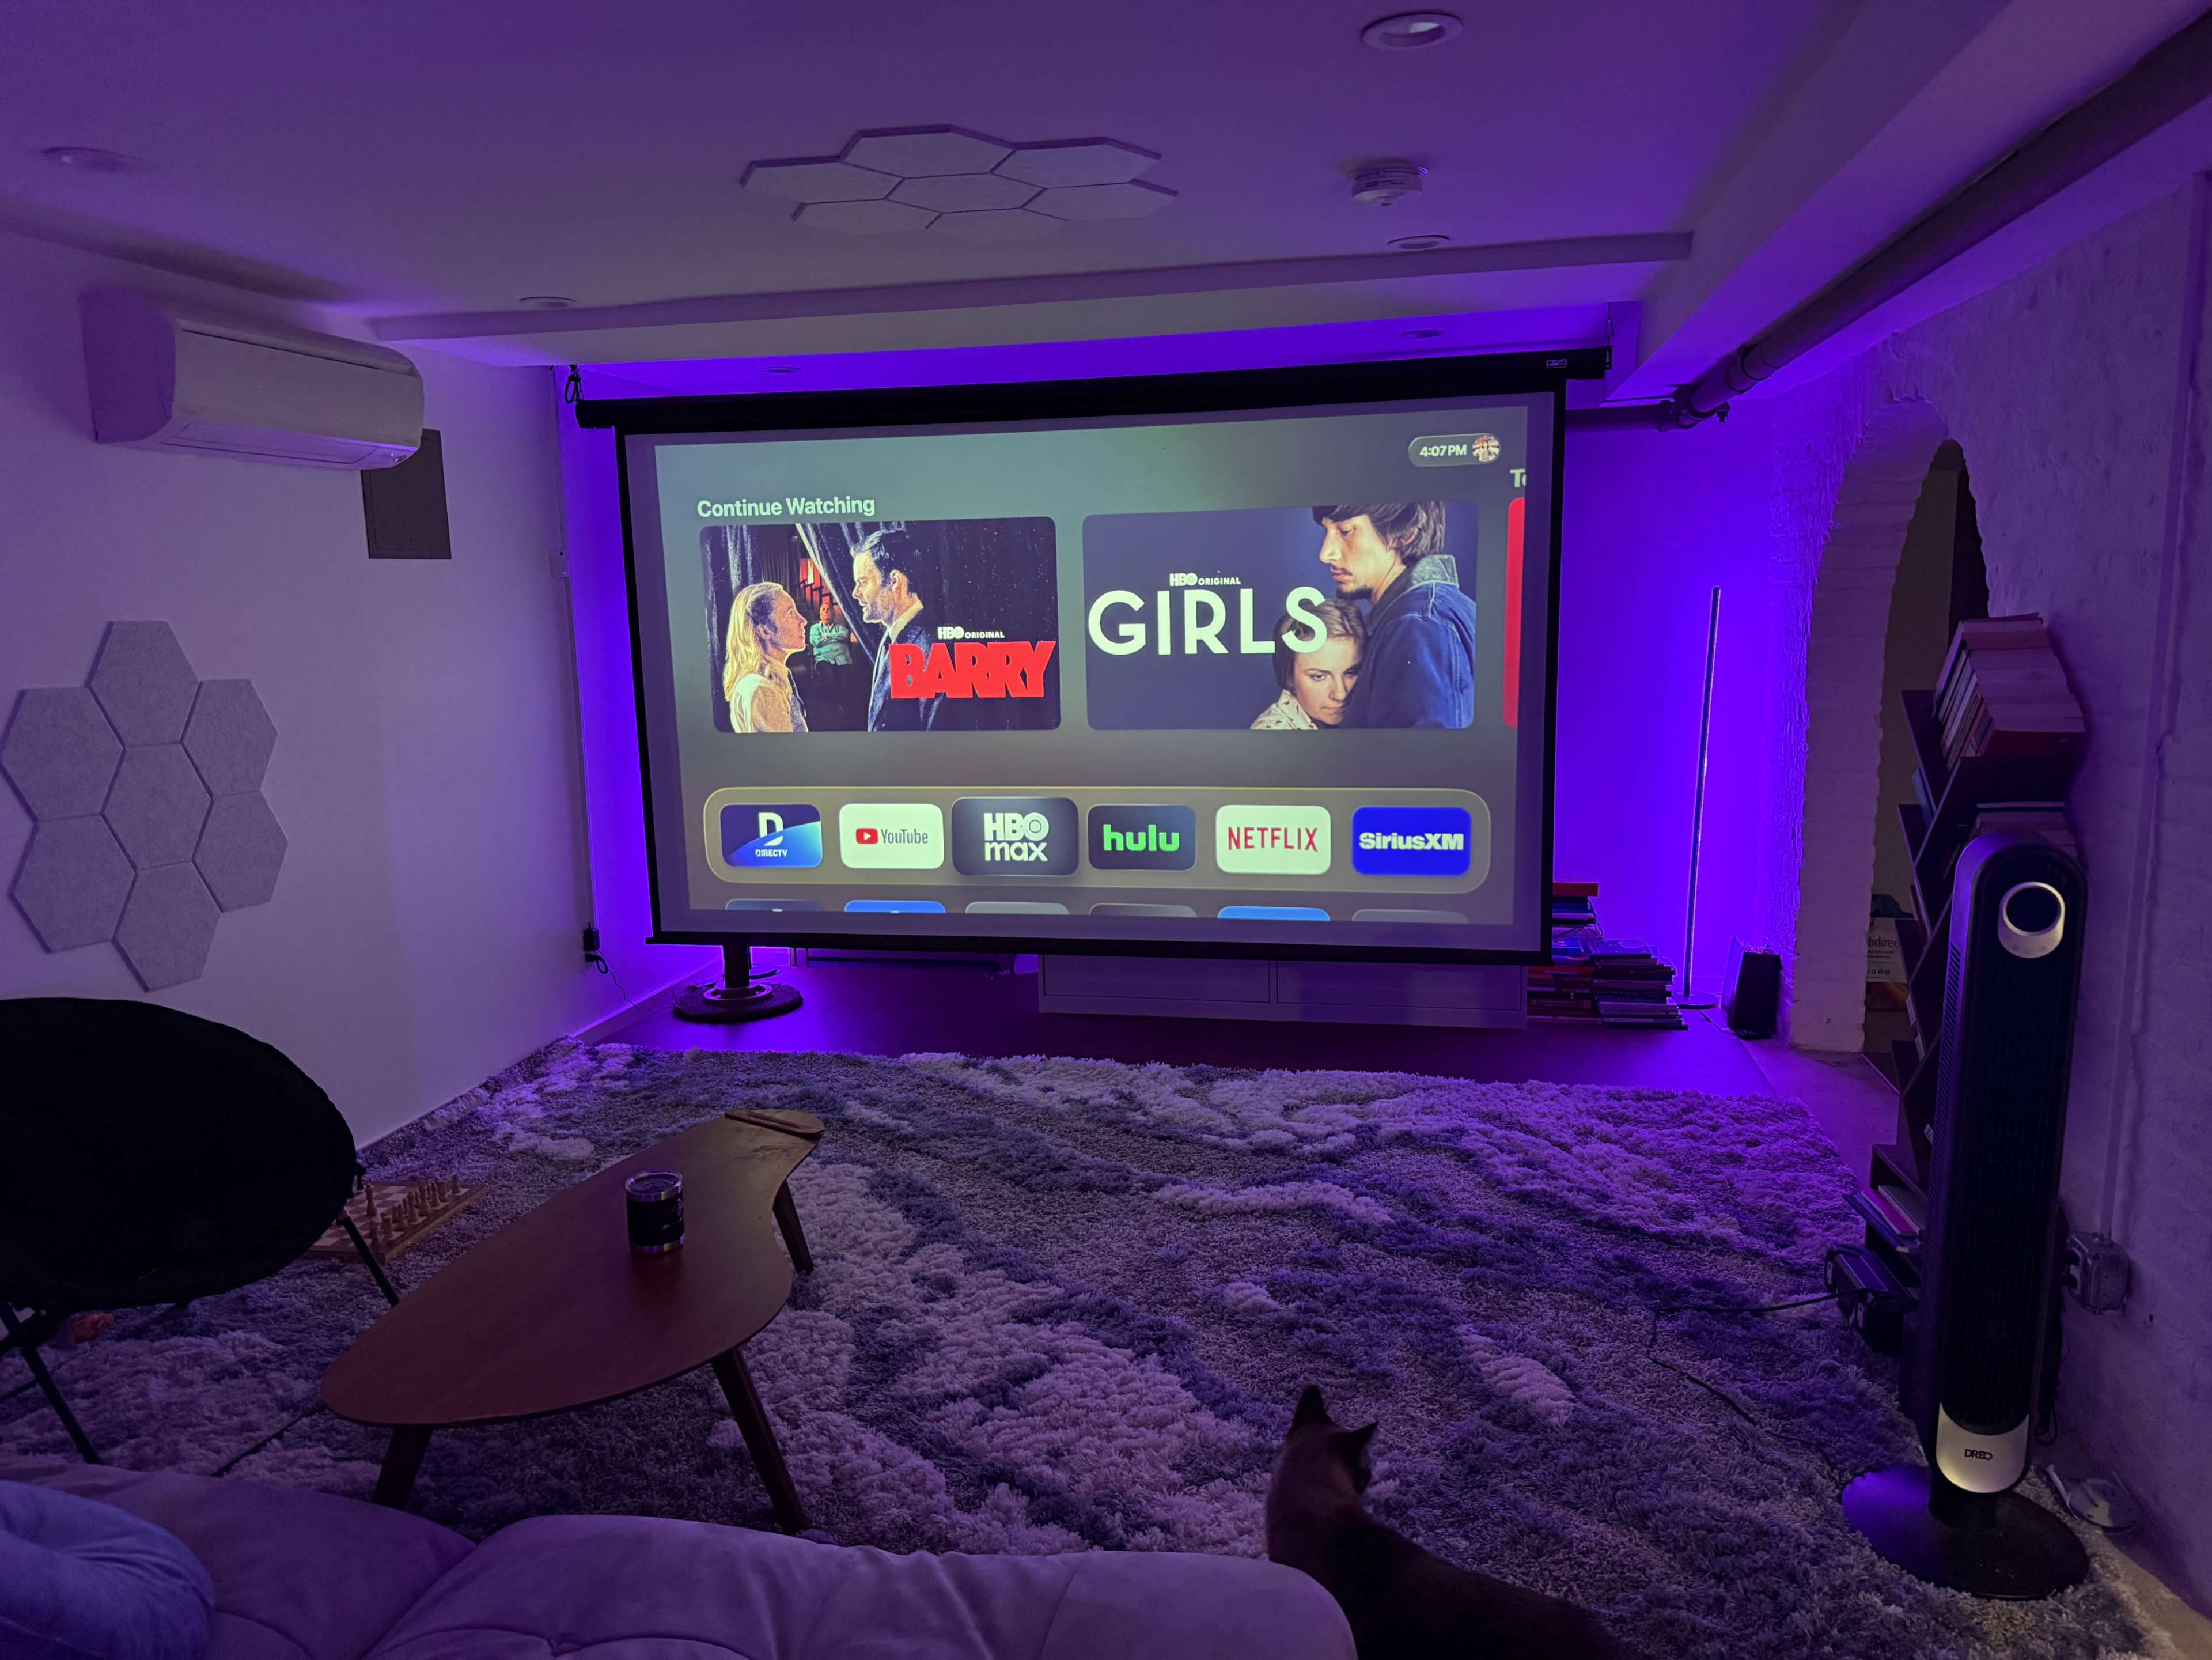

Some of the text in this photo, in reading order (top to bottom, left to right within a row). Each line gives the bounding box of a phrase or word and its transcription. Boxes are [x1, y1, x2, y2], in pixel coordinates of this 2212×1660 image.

[697, 496, 876, 517] Continue Watching
[1169, 572, 1241, 587] HBO ORIGINAL
[1088, 586, 1328, 656] GIRLS
[937, 626, 1005, 640] HBO ORIGINAL
[888, 640, 1056, 699] BARRY
[881, 829, 929, 845] YouTube
[983, 812, 1050, 842] HBO
[1103, 824, 1180, 852] hulu
[1228, 826, 1319, 852] NETFLIX
[1359, 832, 1464, 850] SiriusXM
[755, 849, 787, 857] DIRECTV
[984, 842, 1048, 862] max
[1964, 1449, 1993, 1461] DREO
